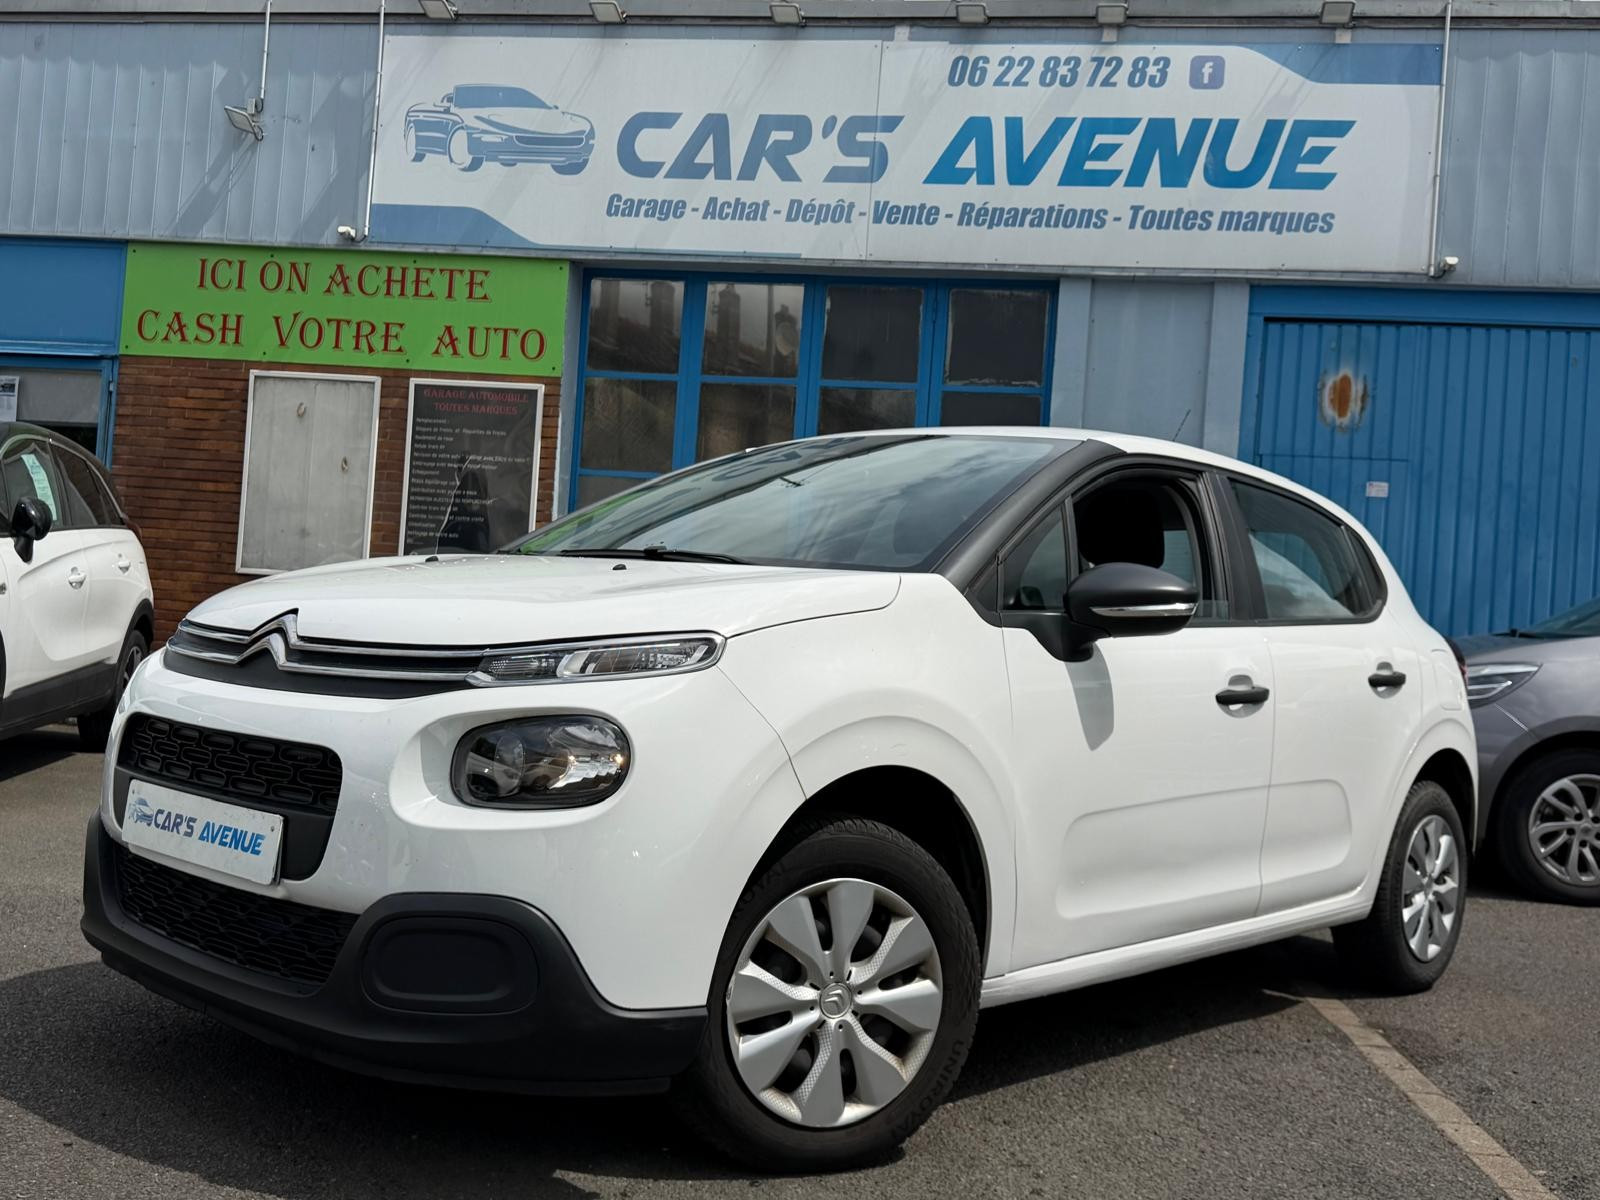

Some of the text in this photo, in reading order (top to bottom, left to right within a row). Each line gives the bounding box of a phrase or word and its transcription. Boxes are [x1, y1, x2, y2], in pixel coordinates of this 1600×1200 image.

[948, 55, 1171, 88] 06 22 83 72 83
[616, 111, 1357, 191] CAR'S AVENUE
[605, 193, 688, 223] Garage
[702, 194, 770, 222] Achat
[785, 196, 856, 226] Dépôt
[872, 200, 940, 227] Vente
[957, 201, 1108, 231] Réparations
[1129, 205, 1213, 232] Toutes
[1217, 210, 1335, 236] marques
[197, 258, 492, 302] ICI ON ACHETE
[137, 309, 547, 361] CASH VOTRE AUTO
[433, 402, 470, 413] TOUTES
[153, 808, 266, 856] CAR'S AVENUE
